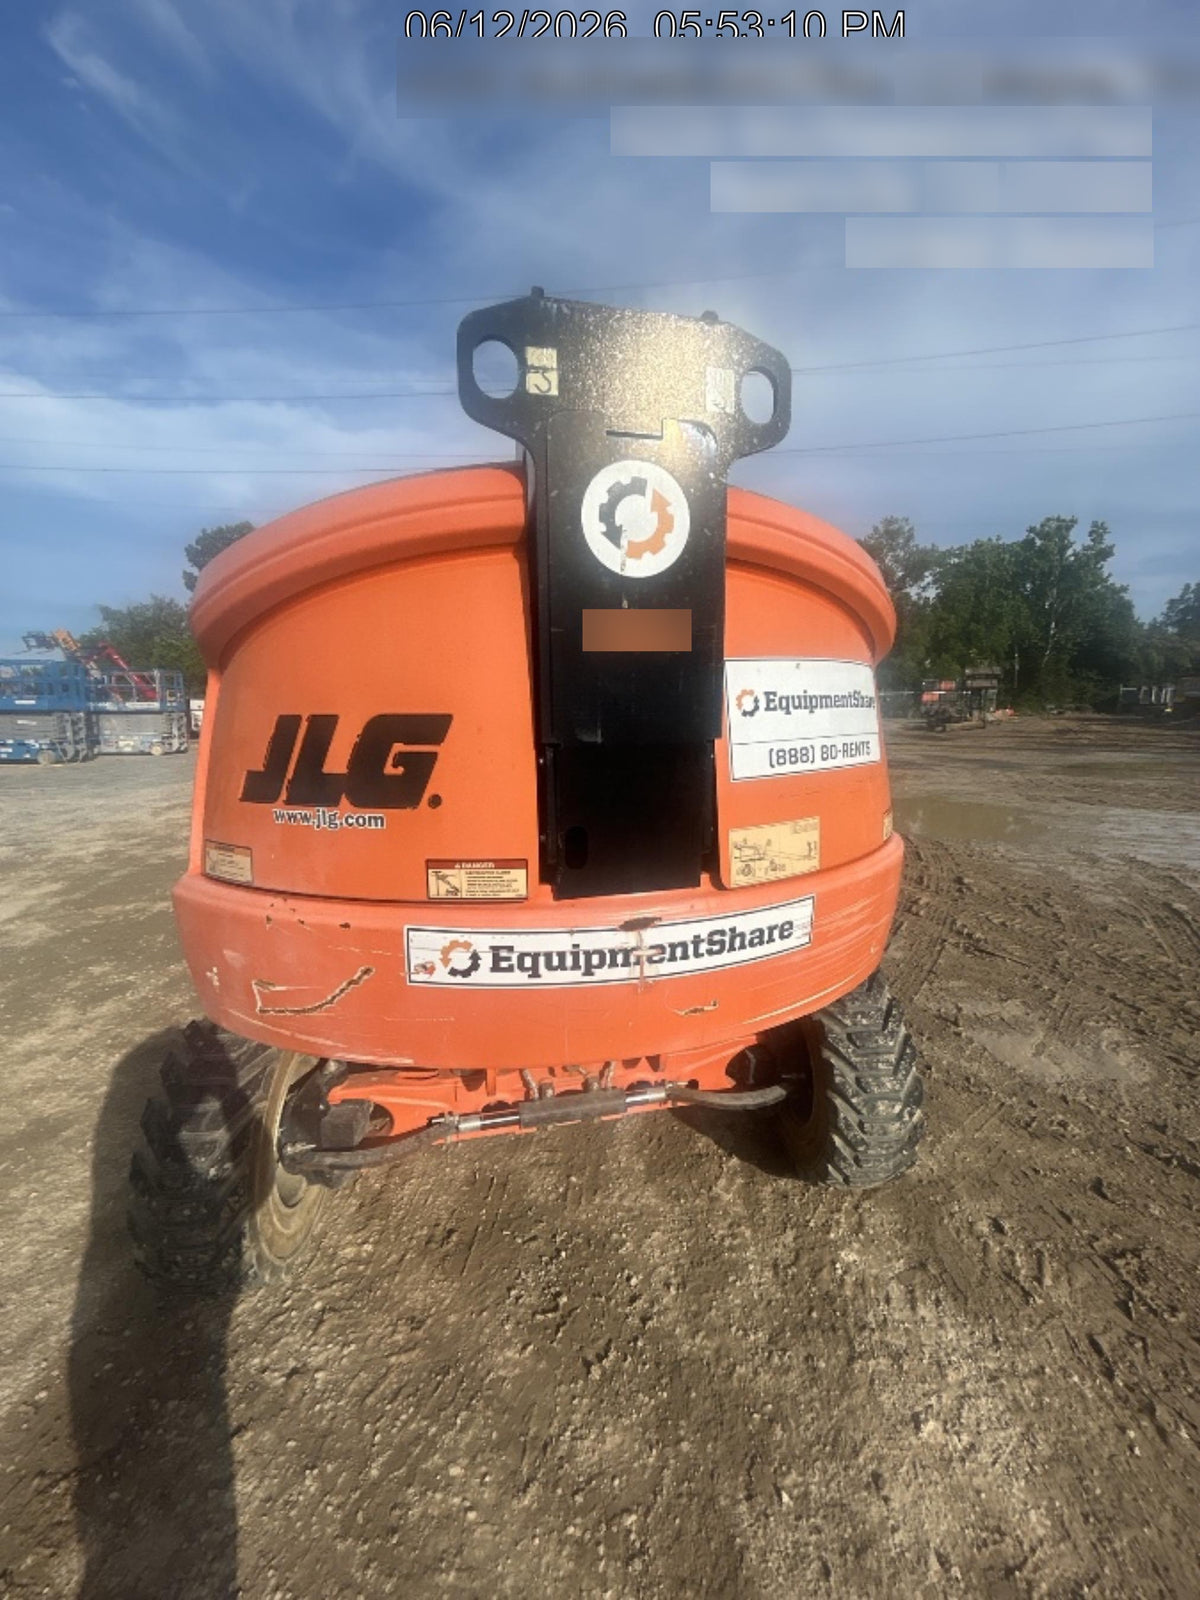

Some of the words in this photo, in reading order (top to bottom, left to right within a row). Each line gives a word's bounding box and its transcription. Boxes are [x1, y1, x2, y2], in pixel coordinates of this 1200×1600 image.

[768, 744, 815, 769] (888)
[273, 808, 385, 829] www.jlg.com
[489, 918, 794, 978] EquipmentShare
